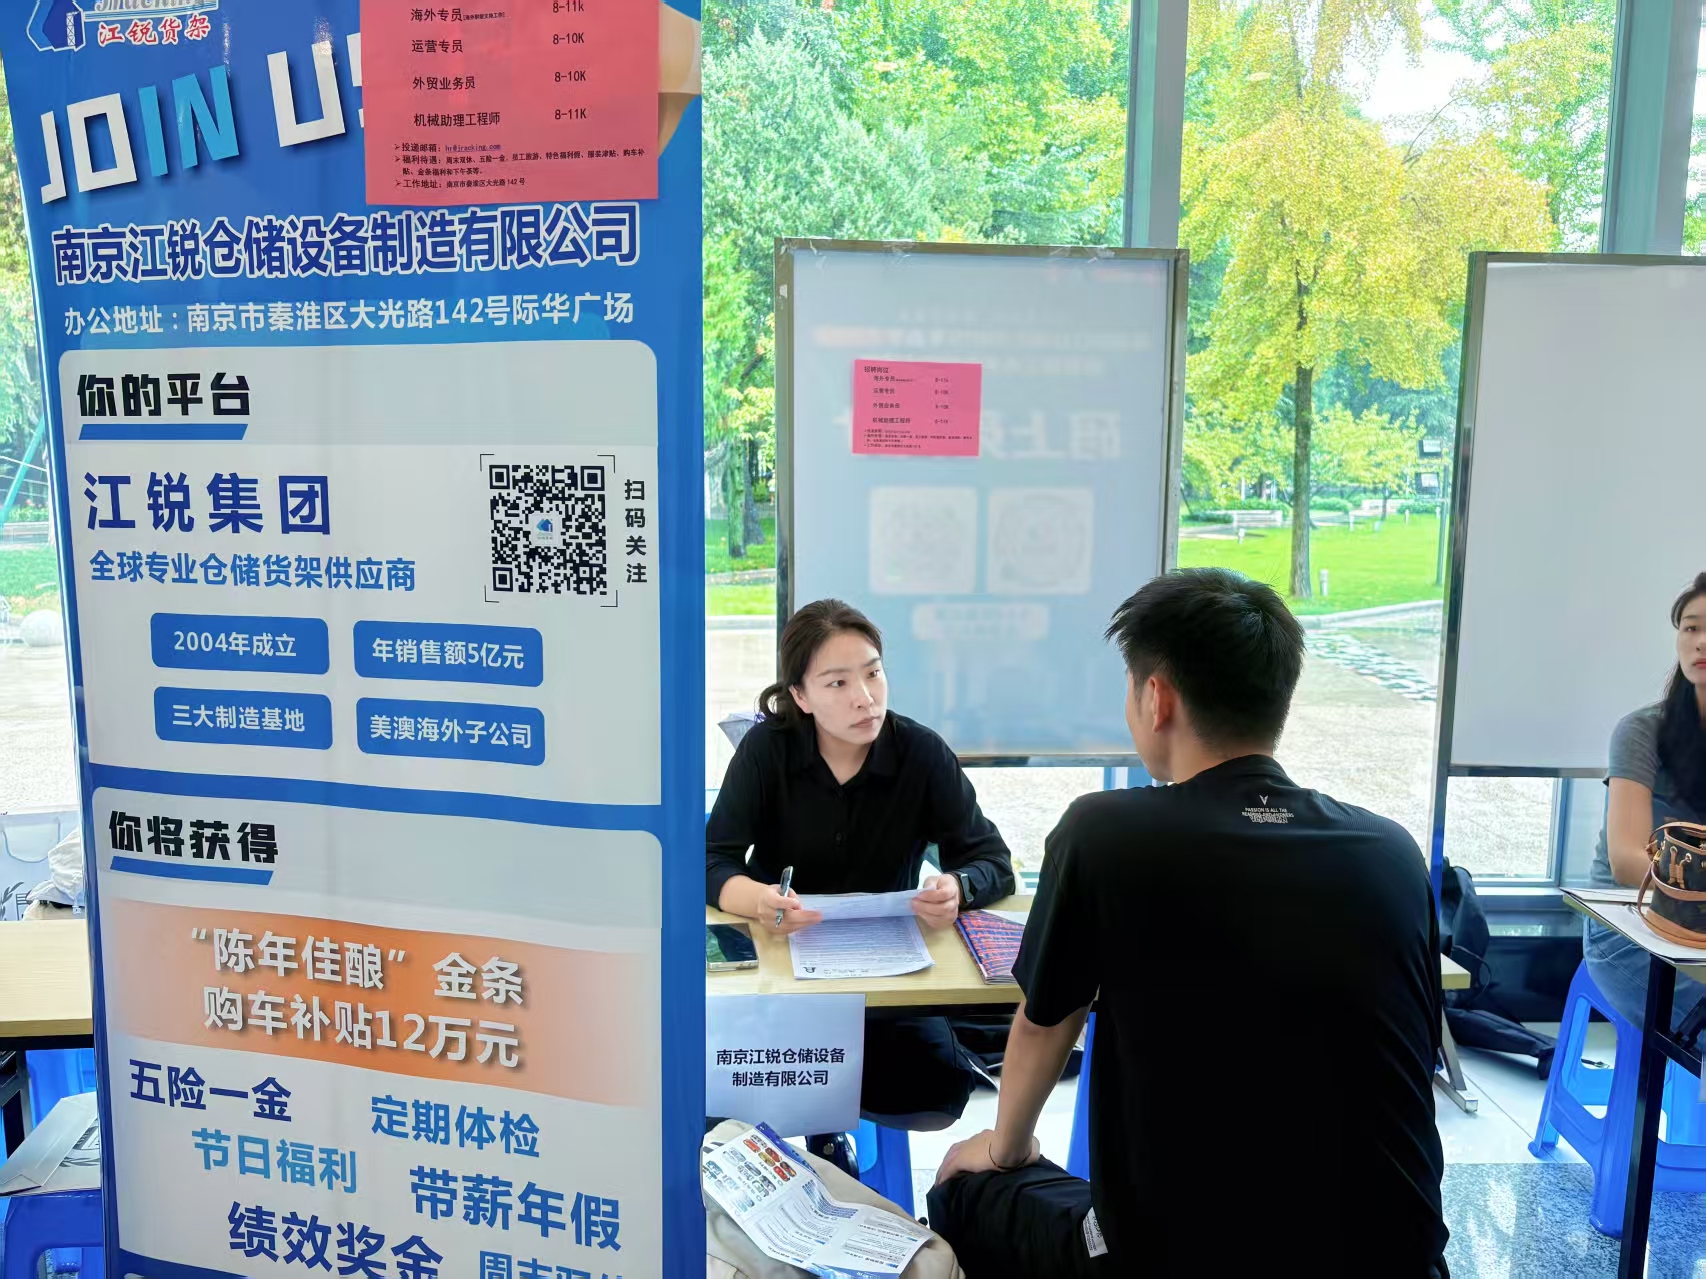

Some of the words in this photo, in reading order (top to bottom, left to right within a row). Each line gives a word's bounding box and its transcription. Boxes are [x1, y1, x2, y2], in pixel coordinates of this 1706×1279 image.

[99, 14, 211, 46] 江锐货架
[411, 8, 463, 21] 海外专员
[553, 0, 584, 13] 8-11k
[412, 39, 463, 53] 运营专员
[553, 32, 584, 44] 8-10K
[413, 76, 476, 90] 外贸业务员
[554, 71, 587, 82] 8-10K
[41, 65, 239, 205] JOIN
[267, 32, 366, 148] U
[413, 111, 501, 127] 机械助理工程师
[554, 108, 587, 120] 8-11K
[52, 203, 639, 285] 南京江锐仓储设备制造有限公司
[64, 292, 634, 335] 办公地址：南京市秦淮区大光路142号际华广场
[77, 372, 251, 417] 你的平台
[84, 472, 330, 535] 江锐集团
[624, 479, 648, 583] 扫码关注
[90, 550, 416, 591] 全球专业仓储货架供应商
[173, 631, 297, 658] 2004年成立
[372, 638, 524, 669] 年销售额5亿元
[172, 705, 306, 733] 三大制造基地
[370, 715, 532, 749] 美澳海外子公司
[109, 811, 278, 863] 你将获得
[432, 952, 524, 1005] 金条
[203, 986, 519, 1068] 购车补贴12万元
[716, 1048, 845, 1066] 南京江锐仓储设备
[732, 1070, 829, 1087] 制造有限公司
[129, 1059, 292, 1122] 五险一金
[371, 1095, 541, 1158] 定期体检
[191, 1128, 357, 1194] 节日福利
[409, 1165, 622, 1251] 带薪年假
[228, 1201, 443, 1279] 绩效奖金
